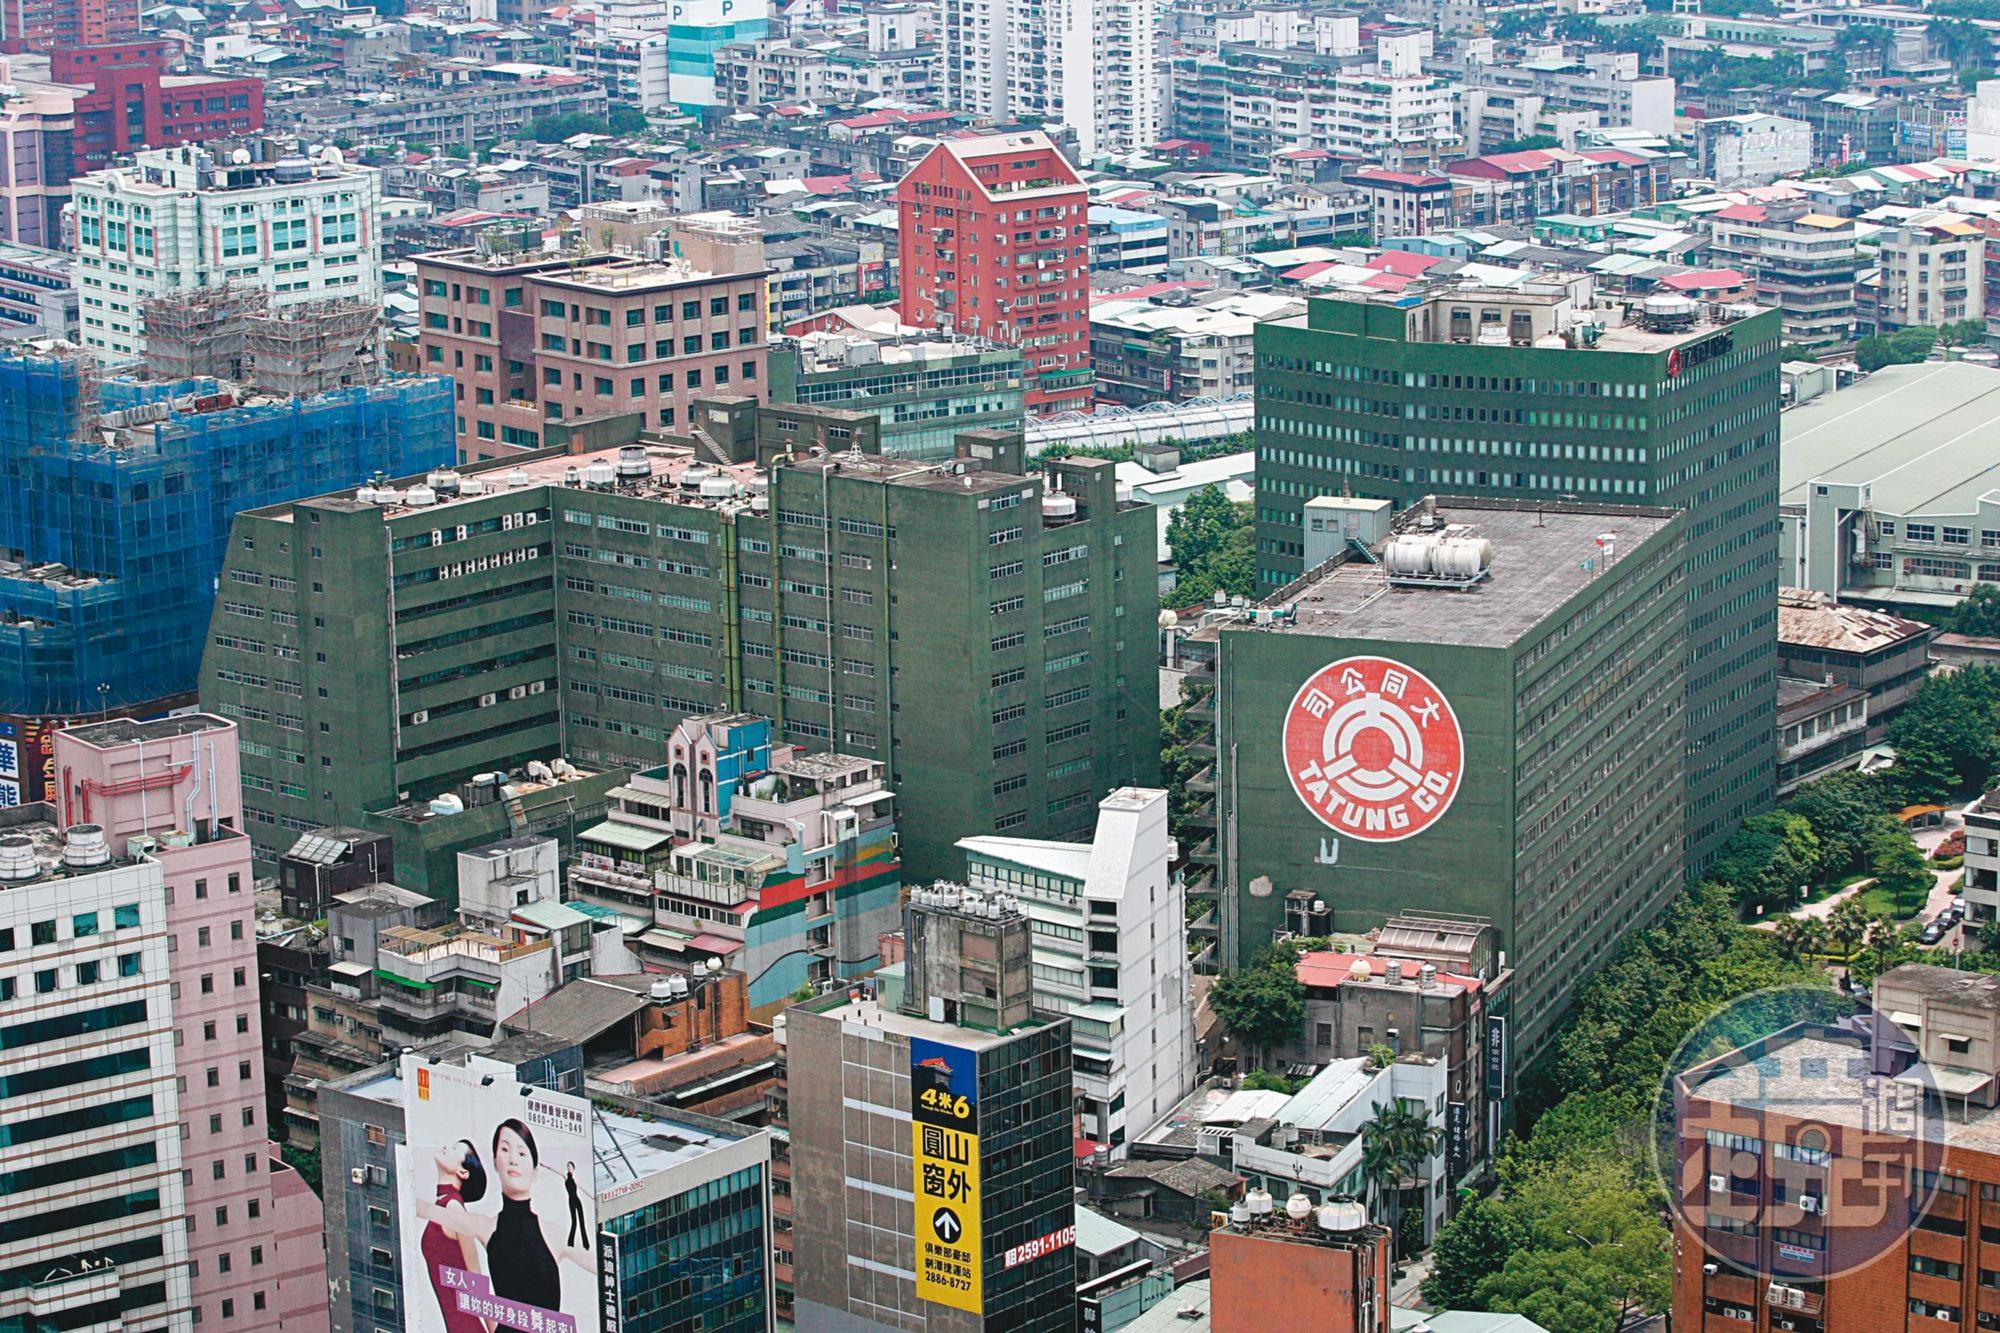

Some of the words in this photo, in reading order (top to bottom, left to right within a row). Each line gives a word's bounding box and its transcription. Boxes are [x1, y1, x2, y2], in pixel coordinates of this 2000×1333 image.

[673, 5, 682, 20] P
[722, 1, 733, 16] P
[1298, 759, 1410, 831] TATUNG
[1411, 769, 1453, 813] CO.
[527, 1111, 582, 1134] 0800-211-049
[922, 1125, 969, 1166] 圓山
[922, 1163, 972, 1205] 窗外
[1017, 1226, 1077, 1264] 2591-1105
[925, 1271, 972, 1292] 2886-8727
